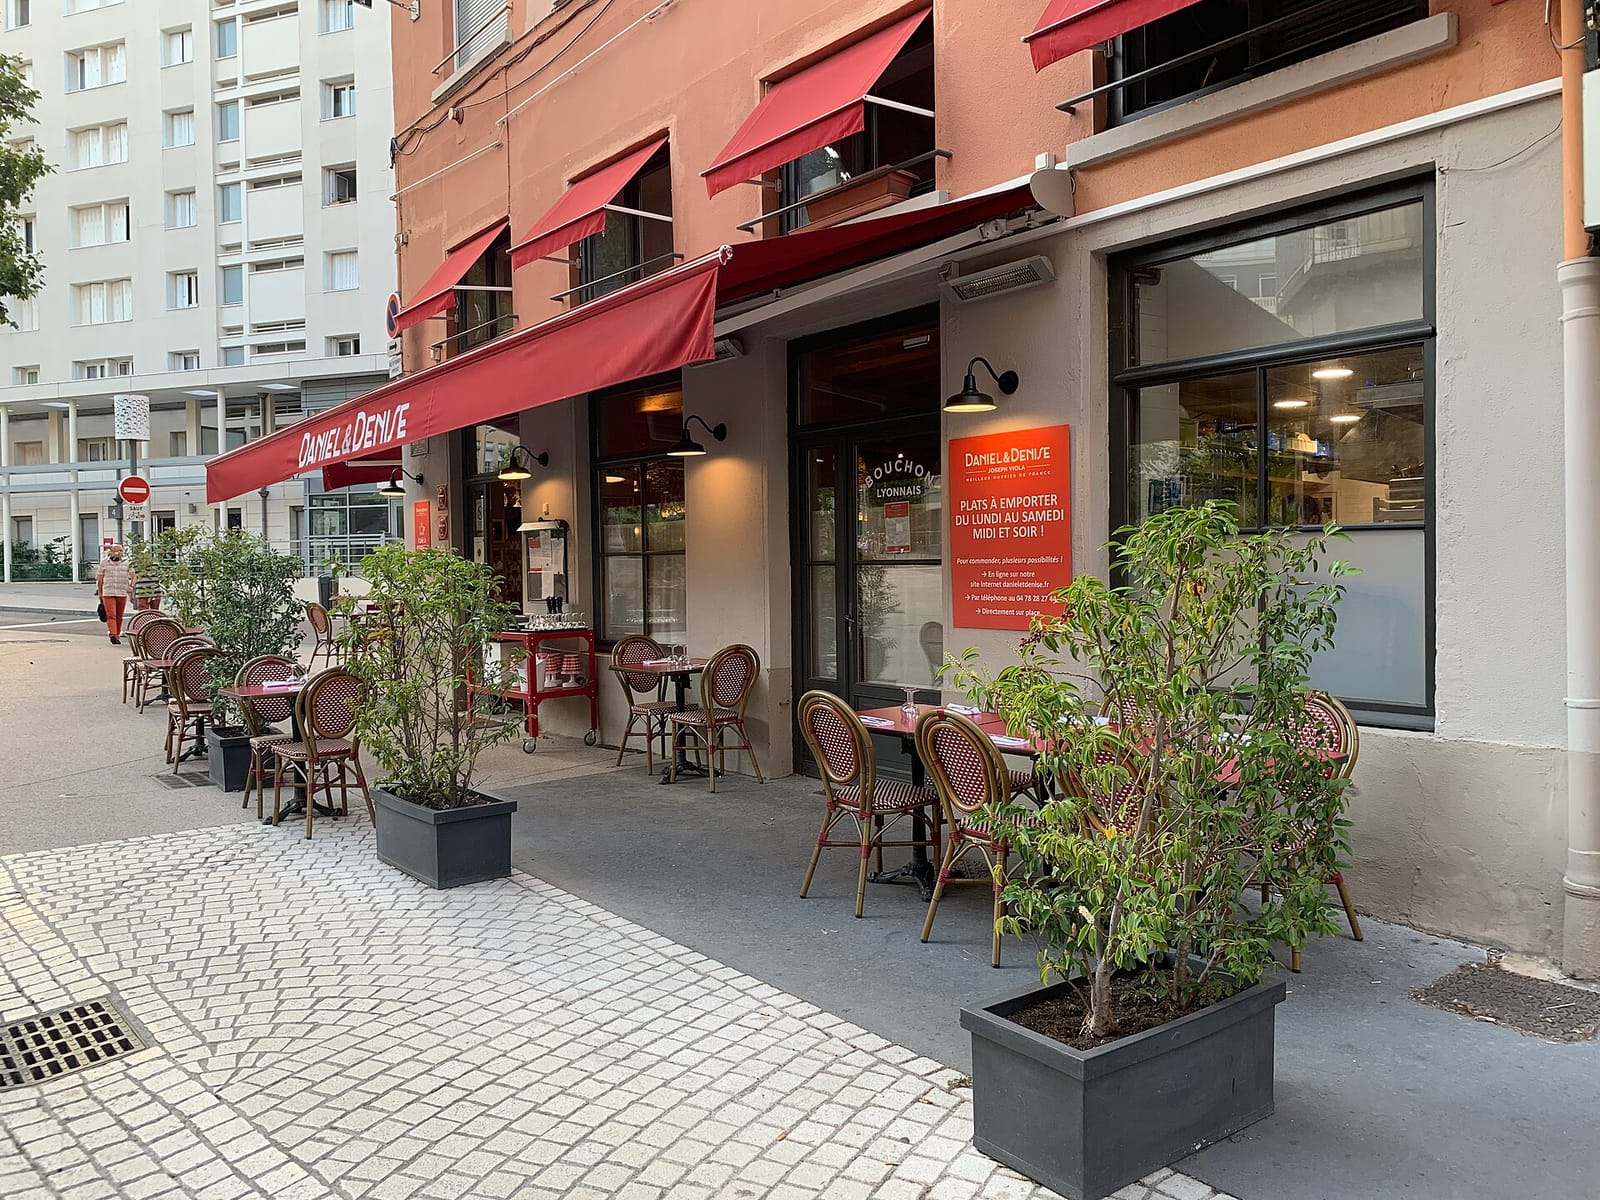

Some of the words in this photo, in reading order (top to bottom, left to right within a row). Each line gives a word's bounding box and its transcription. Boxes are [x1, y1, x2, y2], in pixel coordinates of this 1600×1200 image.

[865, 459, 935, 489] BOUCHON
[988, 466, 1008, 474] JOSEPH
[876, 485, 922, 498] LYONNAIS
[960, 499, 988, 511] PLATS
[990, 496, 998, 510] À
[1000, 494, 1058, 509] EMPORTER
[955, 514, 970, 526] DU
[972, 513, 1002, 525] LUNDI
[1004, 512, 1019, 524] AU
[1022, 509, 1064, 522] SAMEDI
[973, 528, 996, 540] MIDI
[999, 527, 1010, 538] ET
[1013, 526, 1037, 538] SOIR
[1040, 525, 1044, 537] !
[969, 557, 1001, 565] commander,
[1002, 557, 1027, 565] plusieurs
[1027, 556, 1059, 564] possibilités
[996, 571, 1009, 579] ligne
[981, 594, 1008, 602] téléphone
